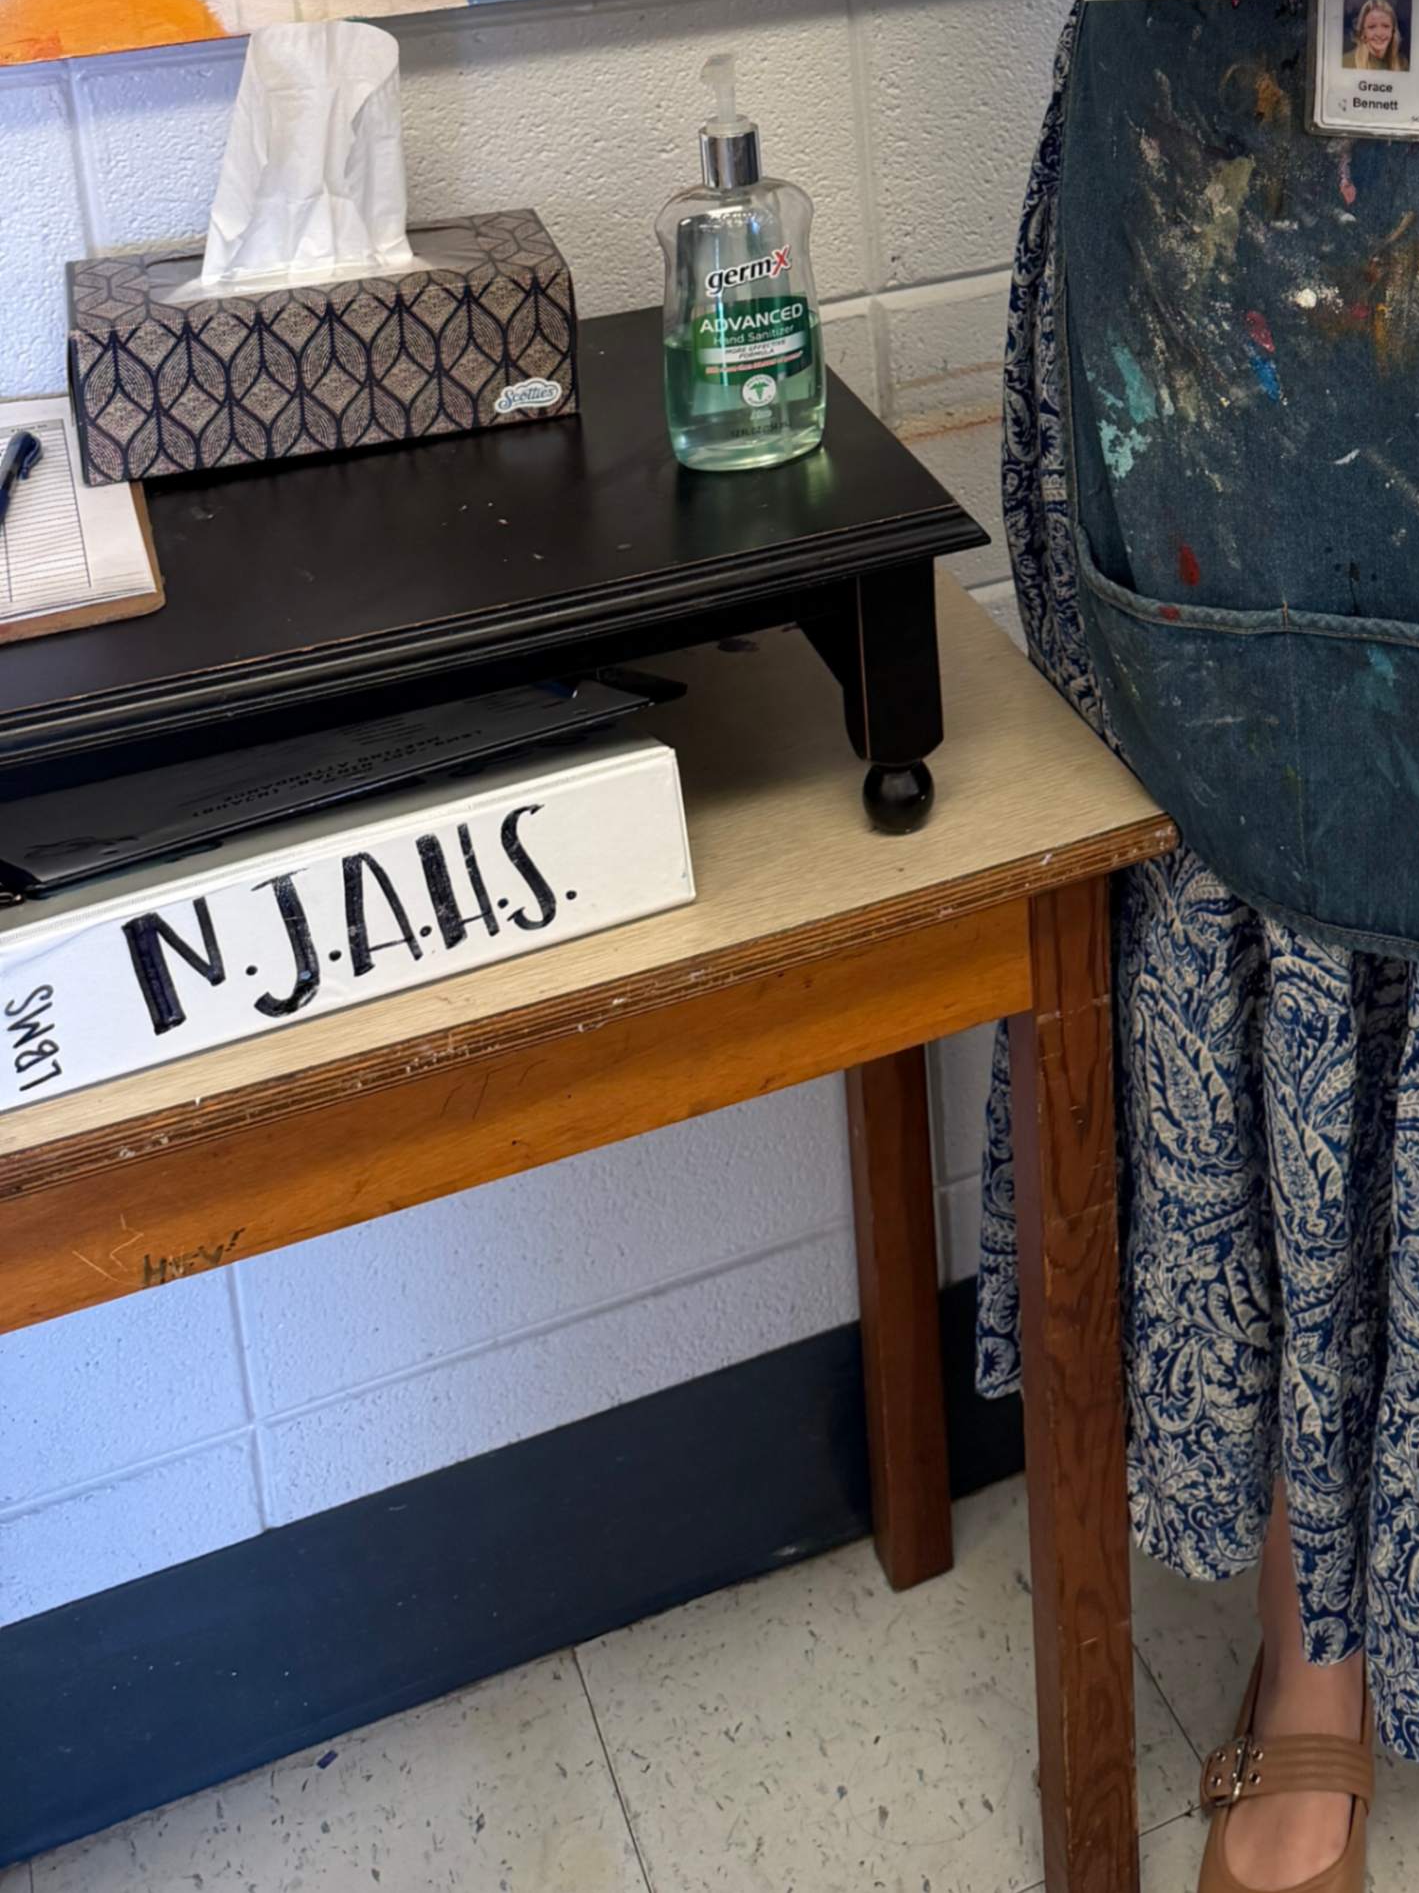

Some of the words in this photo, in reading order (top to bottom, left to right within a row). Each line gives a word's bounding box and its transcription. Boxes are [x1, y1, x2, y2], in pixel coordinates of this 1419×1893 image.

[1357, 80, 1393, 93] Grace
[1352, 97, 1399, 111] Bennett
[699, 302, 803, 334] ADVANCED
[713, 333, 745, 346] Hand
[747, 324, 794, 342] Sanitizer
[498, 386, 554, 410] Scotties
[4, 983, 62, 1092] LBMS
